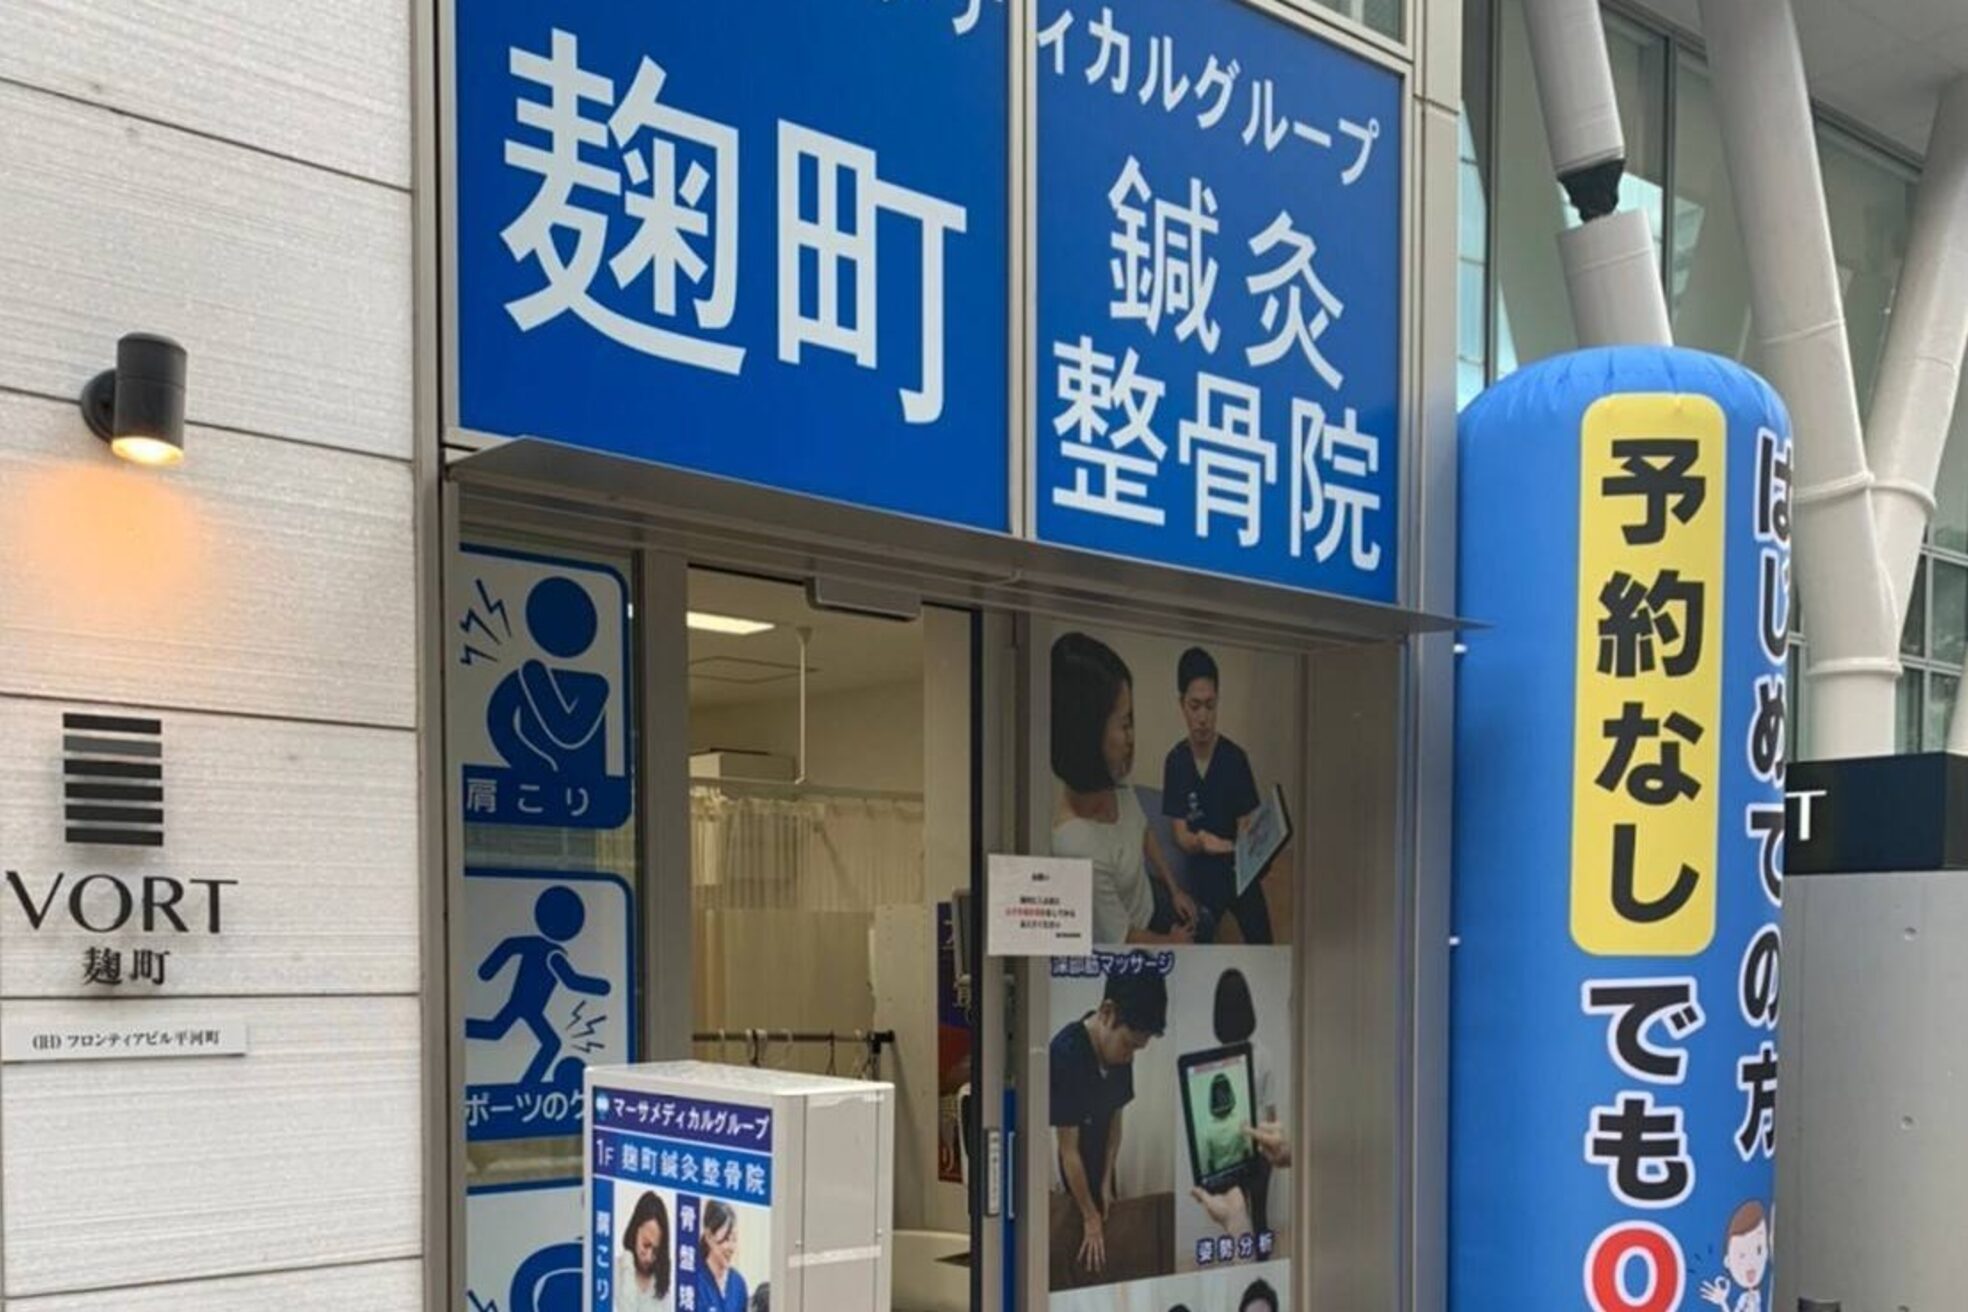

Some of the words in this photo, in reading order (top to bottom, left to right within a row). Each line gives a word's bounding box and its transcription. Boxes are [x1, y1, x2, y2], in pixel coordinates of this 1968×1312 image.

[499, 27, 967, 424] 麹町
[1107, 155, 1345, 391] 鍼灸
[1052, 335, 1382, 572] 整骨院
[466, 778, 590, 817] 肩こり
[5, 870, 239, 934] VORT
[81, 945, 171, 986] 麹町
[595, 1138, 615, 1167] 1F
[621, 1143, 766, 1195] 麹町鍼灸整骨院
